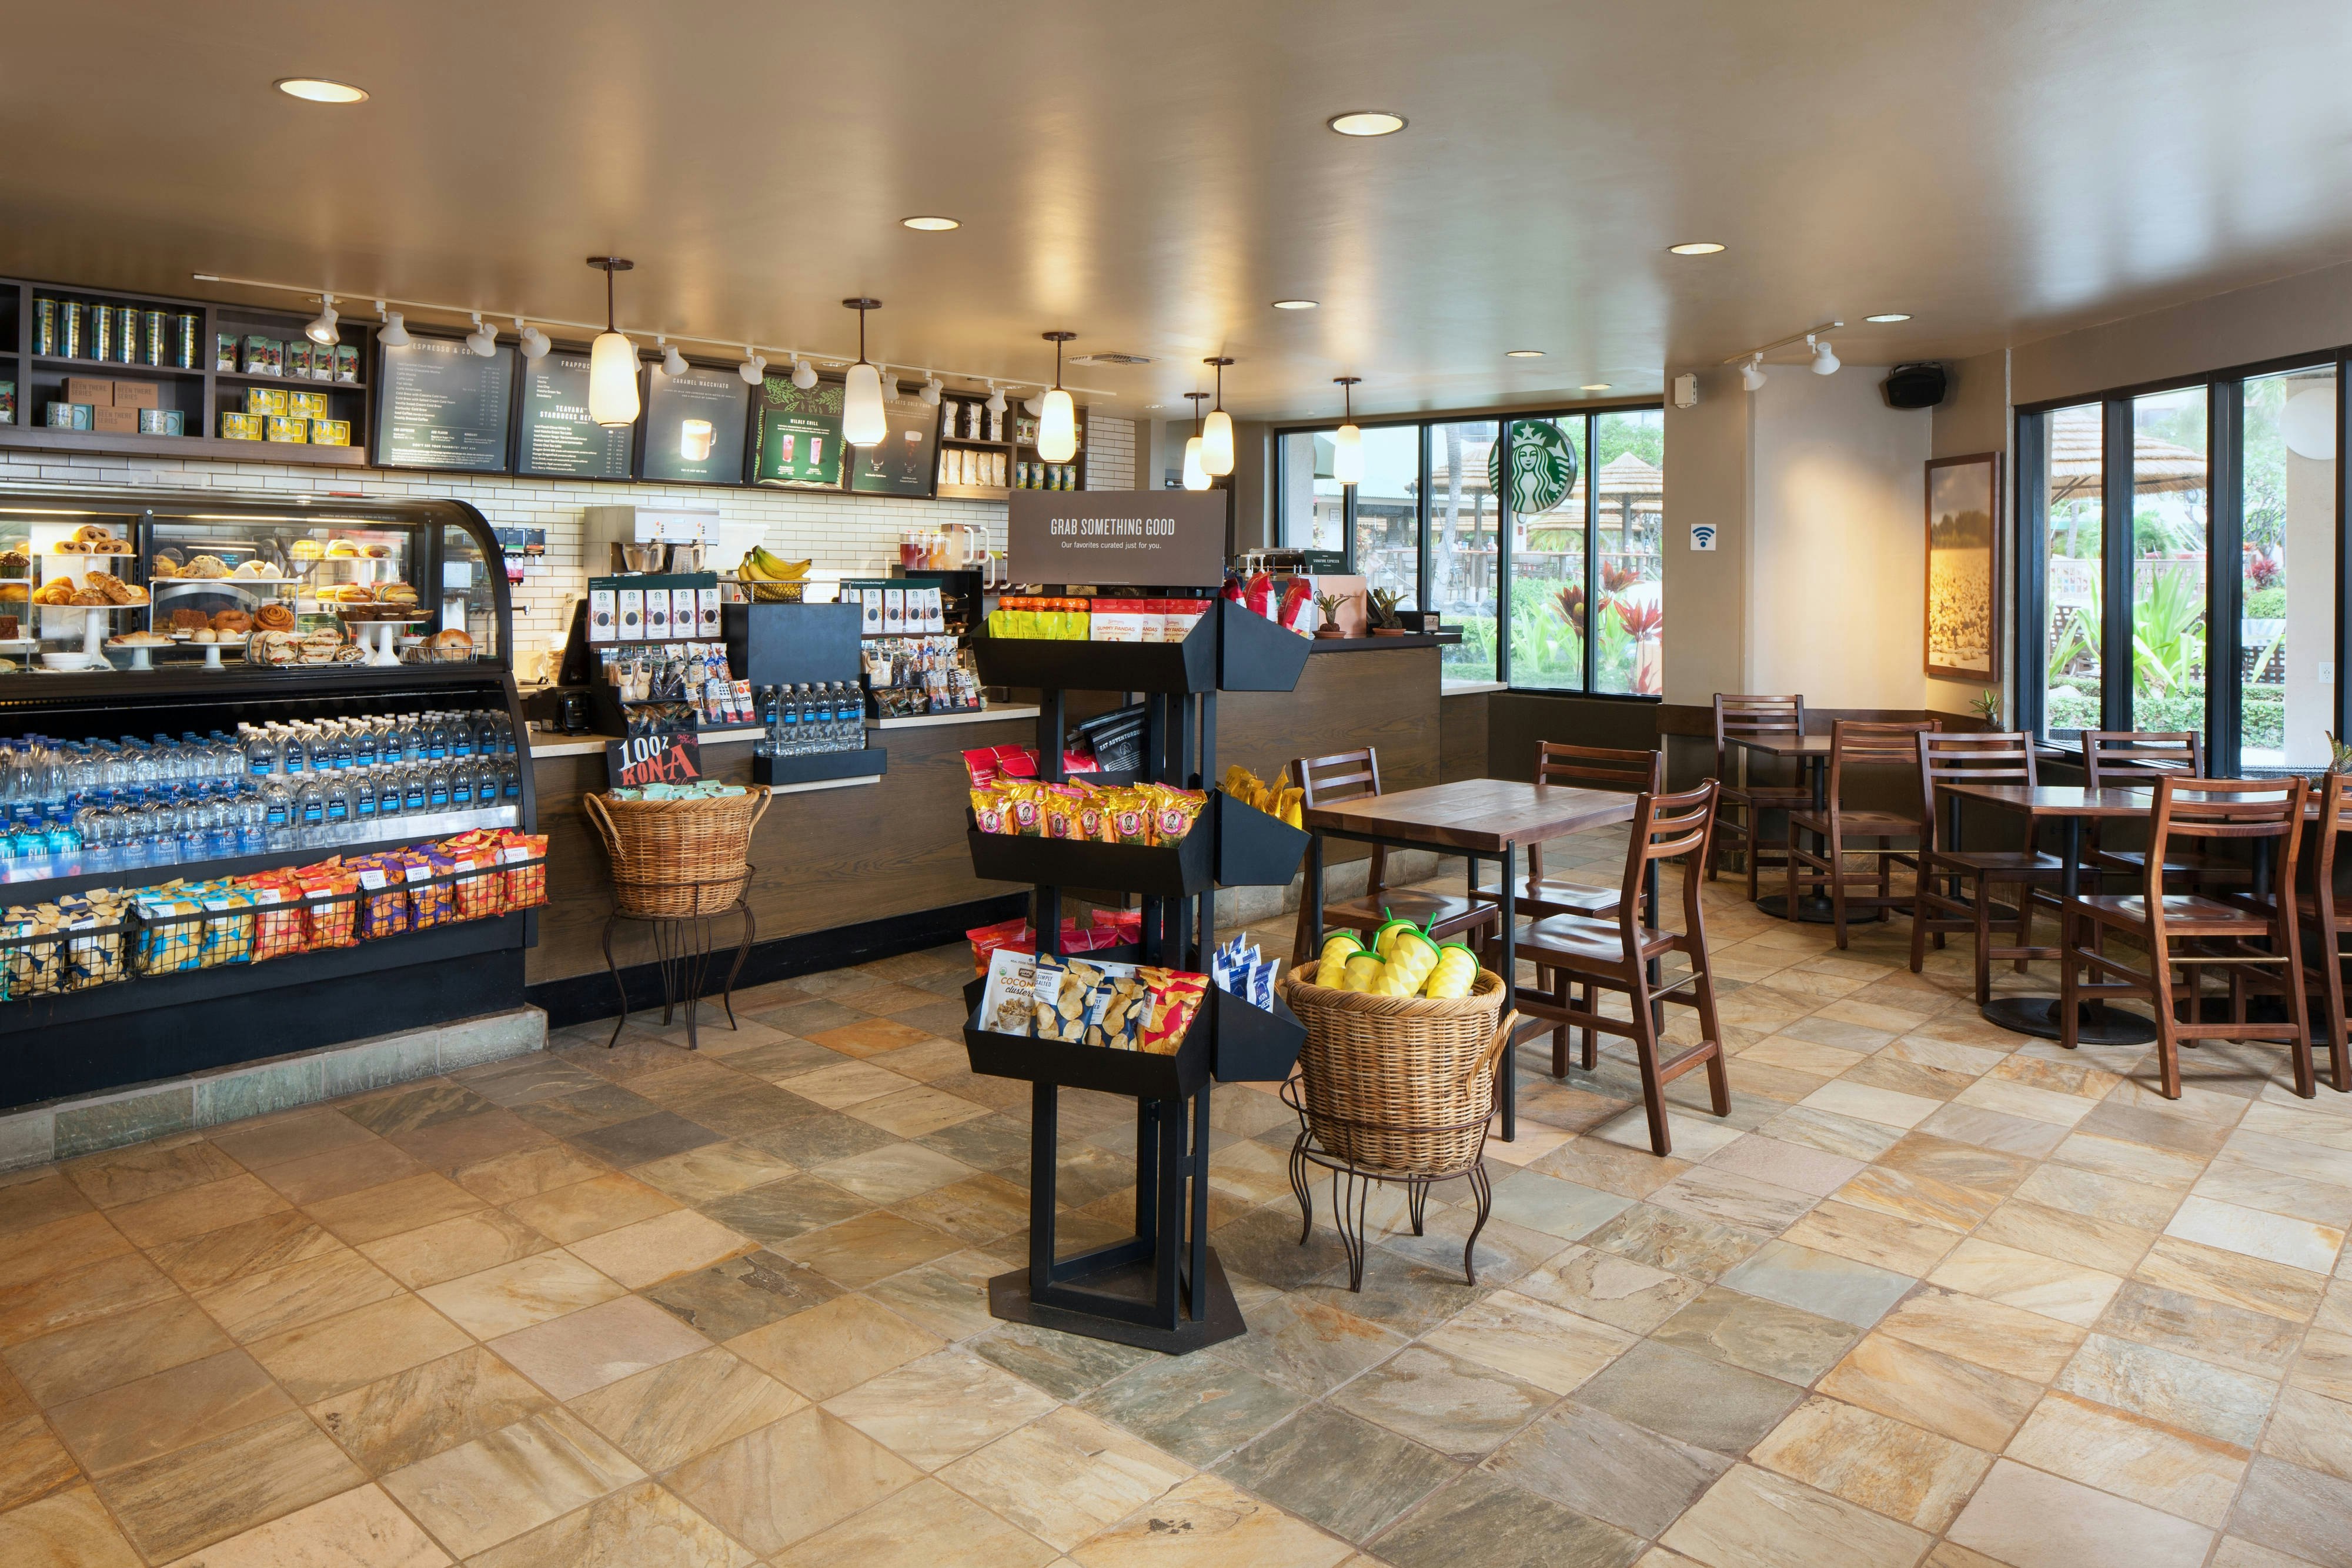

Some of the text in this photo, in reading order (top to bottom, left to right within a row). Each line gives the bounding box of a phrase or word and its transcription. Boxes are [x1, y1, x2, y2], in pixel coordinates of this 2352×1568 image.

[413, 343, 449, 353] ESPRESSO
[562, 360, 591, 369] FRAPPUC
[540, 412, 577, 420] STARBUCKS
[1051, 519, 1175, 536] GRAB SOMETHING GOOD
[1125, 541, 1137, 550] just
[1100, 729, 1143, 751] EAT ADVENTUROU
[618, 735, 669, 772] 100%
[622, 744, 701, 786] KONA
[28, 847, 48, 861] FIJI
[61, 844, 79, 859] FIJI
[1001, 977, 1035, 989] COCON
[1005, 986, 1033, 998] clusters
[1258, 992, 1267, 1002] OON
